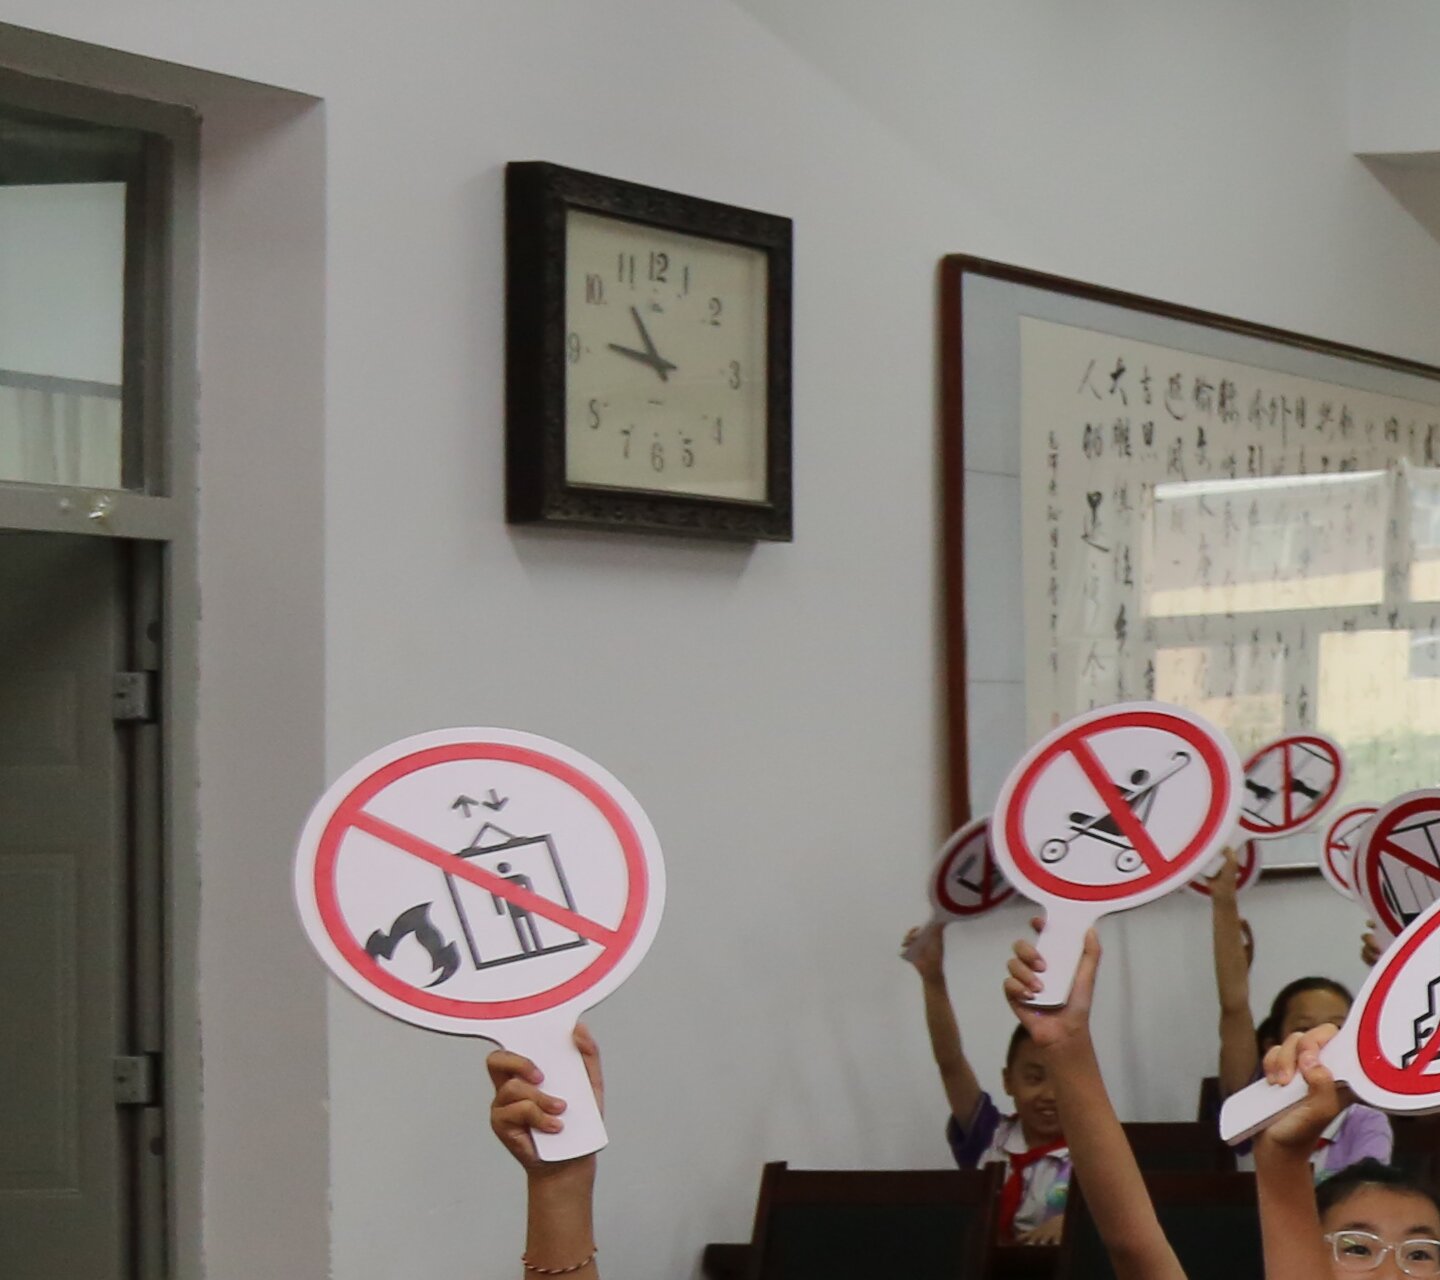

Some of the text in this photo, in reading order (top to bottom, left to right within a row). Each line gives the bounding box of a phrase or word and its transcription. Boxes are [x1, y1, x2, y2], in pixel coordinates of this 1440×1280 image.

[618, 252, 634, 285] 11
[649, 251, 669, 284] 12
[585, 272, 604, 304] 10
[709, 297, 722, 326] 2
[568, 332, 580, 363] 9
[729, 360, 741, 390] 3
[589, 399, 600, 430] 8
[621, 428, 631, 460] 7
[651, 442, 664, 473] 6
[682, 438, 694, 468] 5
